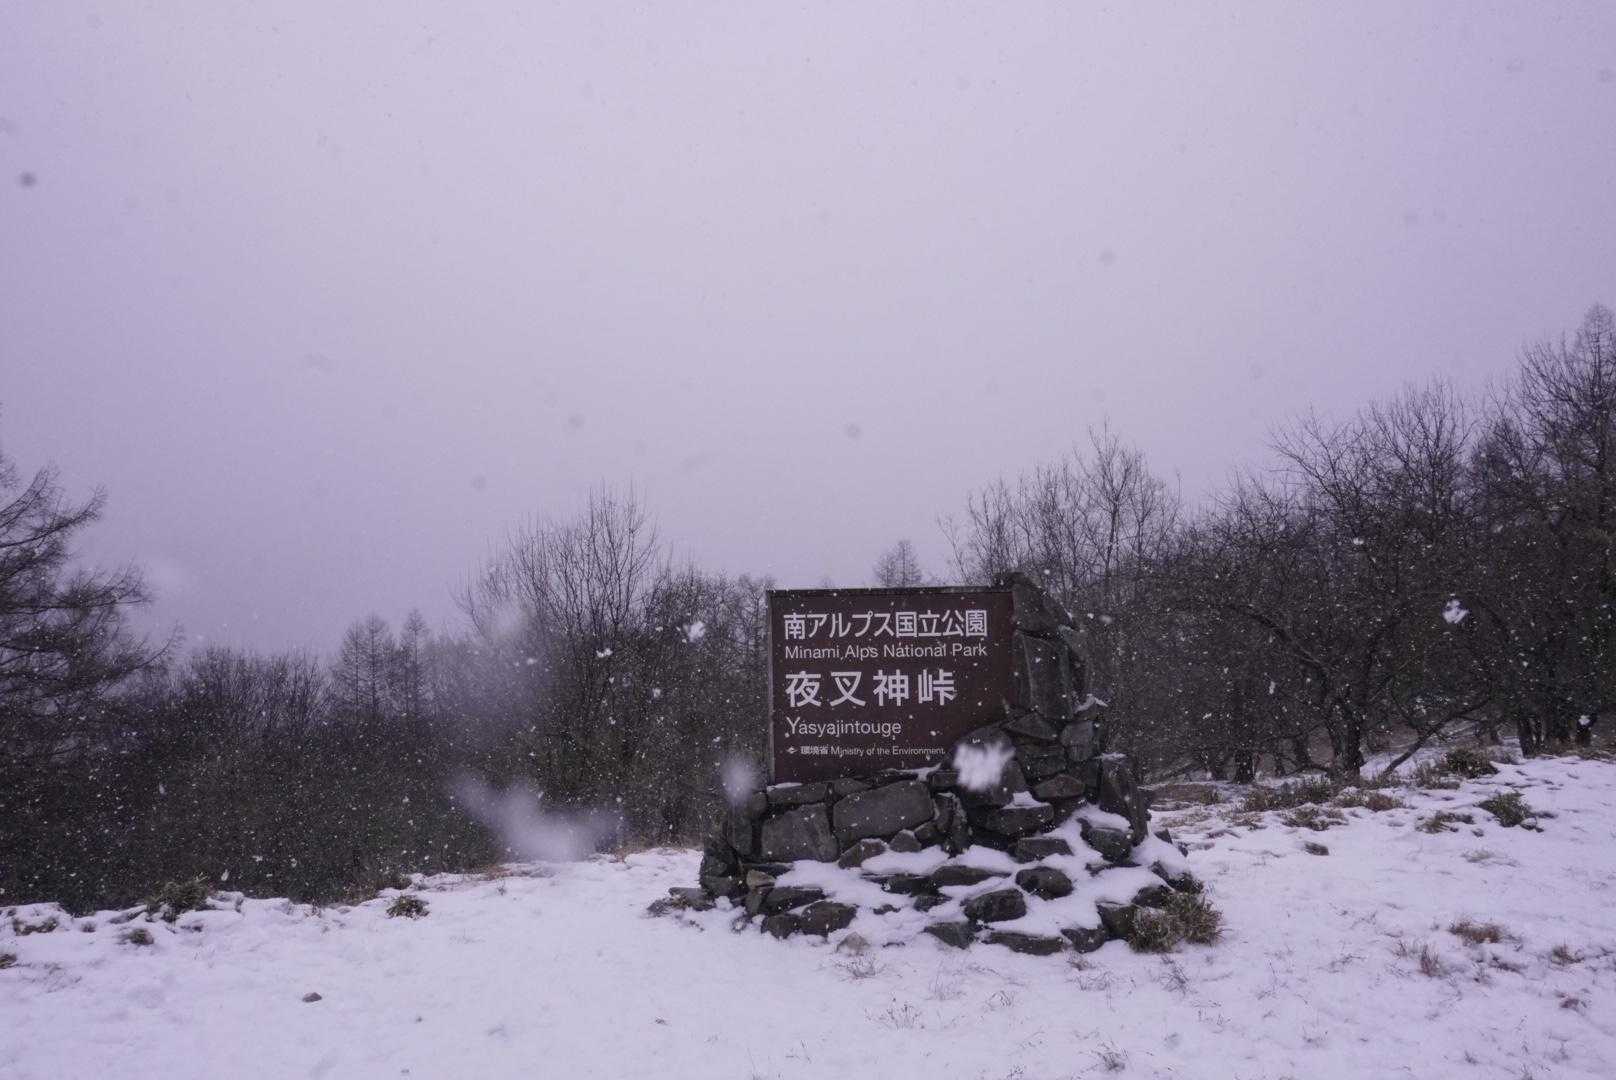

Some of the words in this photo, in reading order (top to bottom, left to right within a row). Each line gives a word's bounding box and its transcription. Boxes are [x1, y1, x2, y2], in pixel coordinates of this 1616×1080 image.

[783, 610, 988, 640] 南アルプス国立公園
[784, 646, 840, 659] Minami
[883, 643, 947, 658] National
[952, 642, 988, 657] Park
[785, 669, 957, 707] 夜叉神峠
[786, 716, 902, 737] Yasyajintouge
[877, 746, 890, 756] the
